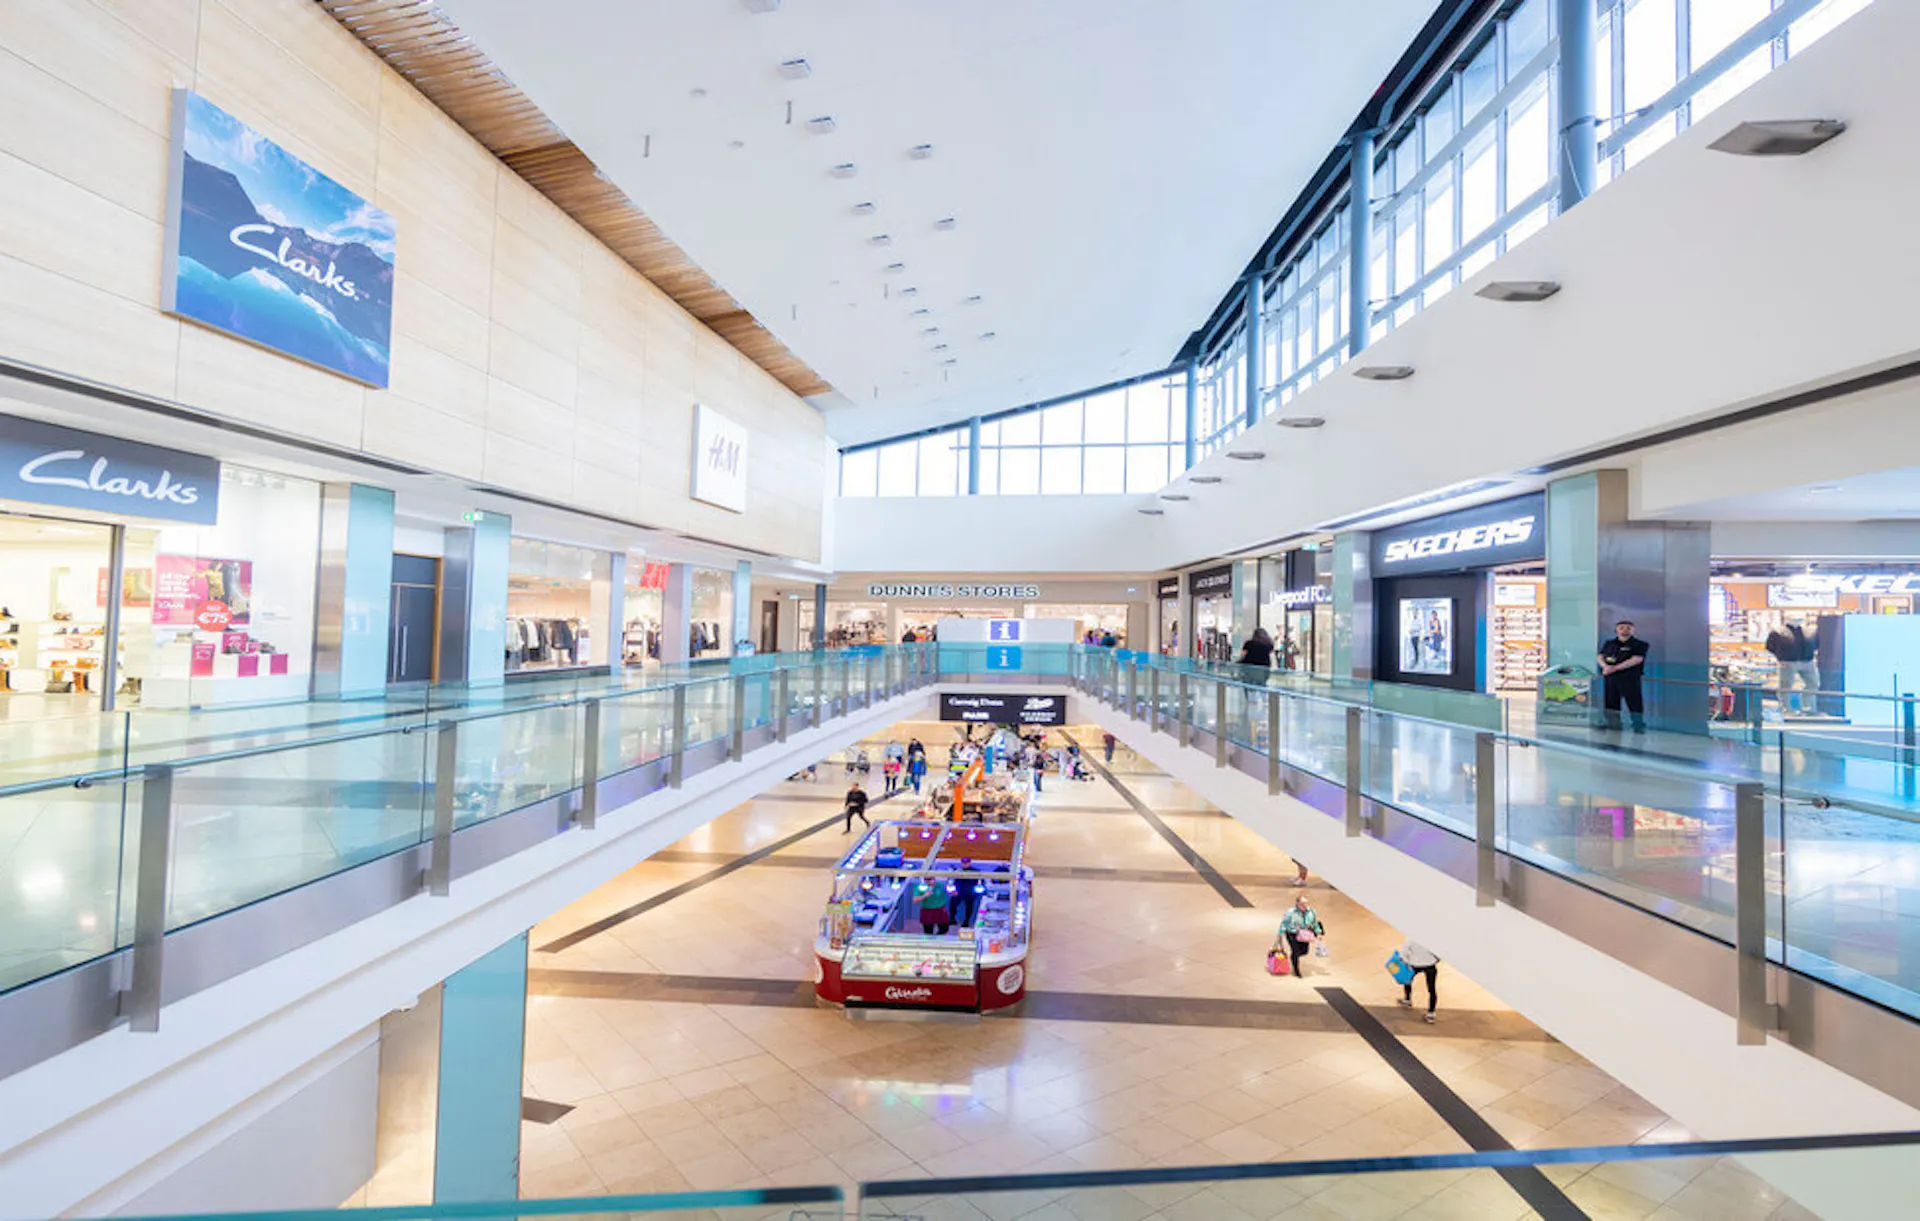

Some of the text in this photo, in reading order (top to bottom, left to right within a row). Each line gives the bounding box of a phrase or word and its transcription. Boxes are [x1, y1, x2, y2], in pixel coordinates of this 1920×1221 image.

[18, 449, 199, 505] Clarks
[1384, 515, 1535, 563] SKECHERS
[869, 584, 1040, 598] DUNNES STORES
[198, 611, 229, 624] €75
